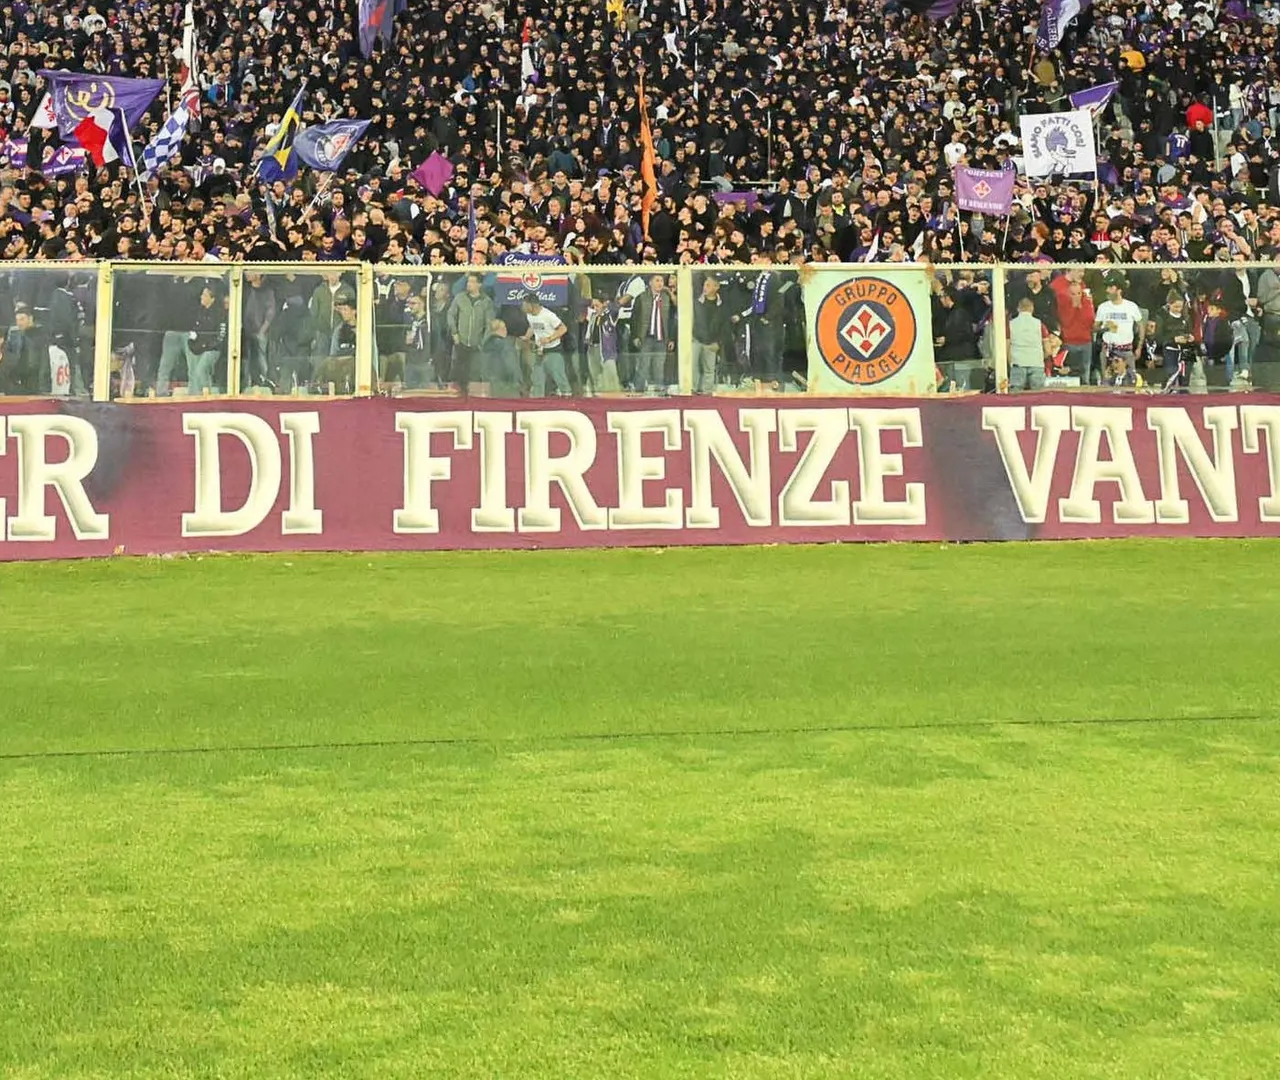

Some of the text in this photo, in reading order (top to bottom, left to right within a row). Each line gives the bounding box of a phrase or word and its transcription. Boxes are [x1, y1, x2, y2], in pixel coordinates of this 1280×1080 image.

[1040, 116, 1071, 128] FATTI
[834, 283, 898, 307] GRUPPO
[832, 351, 903, 379] PIAGGE
[181, 410, 323, 538] DI
[392, 407, 927, 534] FIRENZE
